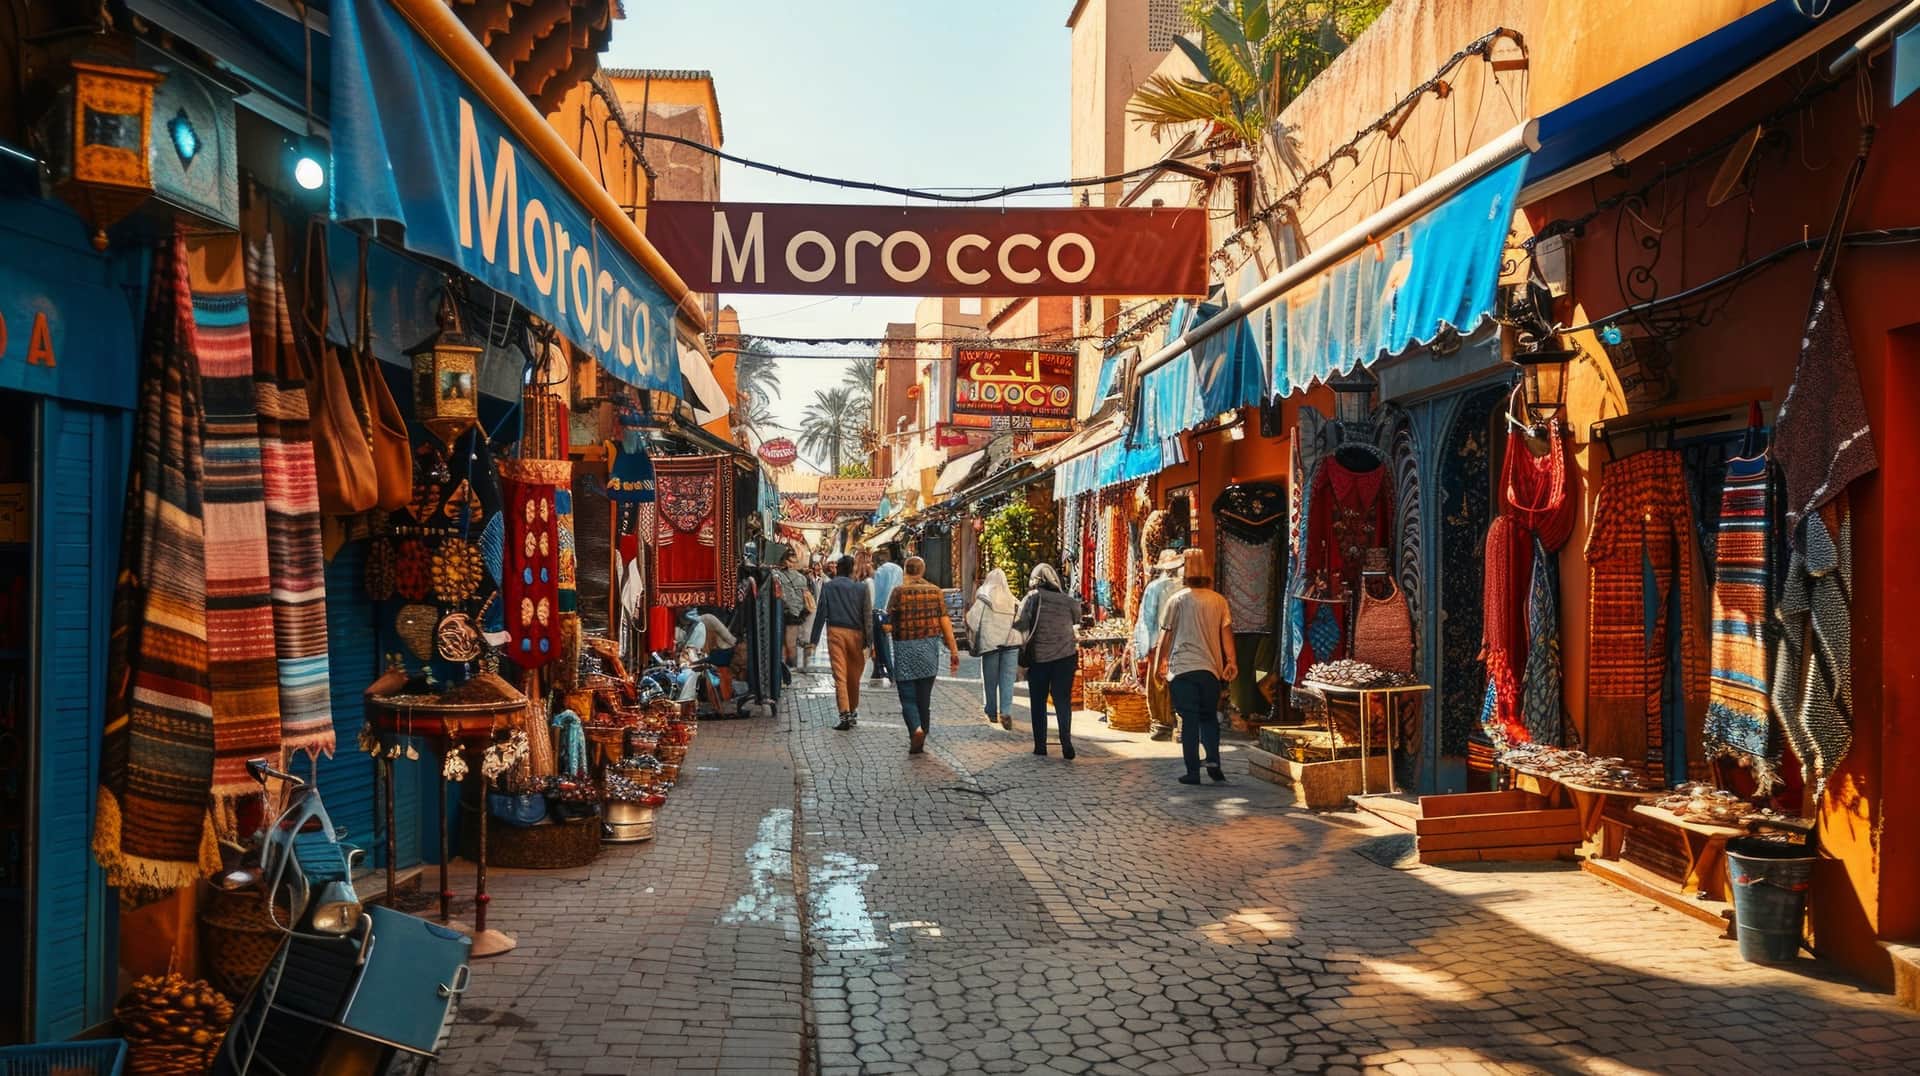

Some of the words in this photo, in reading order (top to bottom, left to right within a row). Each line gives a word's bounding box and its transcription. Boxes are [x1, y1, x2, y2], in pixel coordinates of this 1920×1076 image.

[458, 97, 651, 376] Morocco
[711, 211, 1096, 285] Morocco
[0, 311, 56, 367] A
